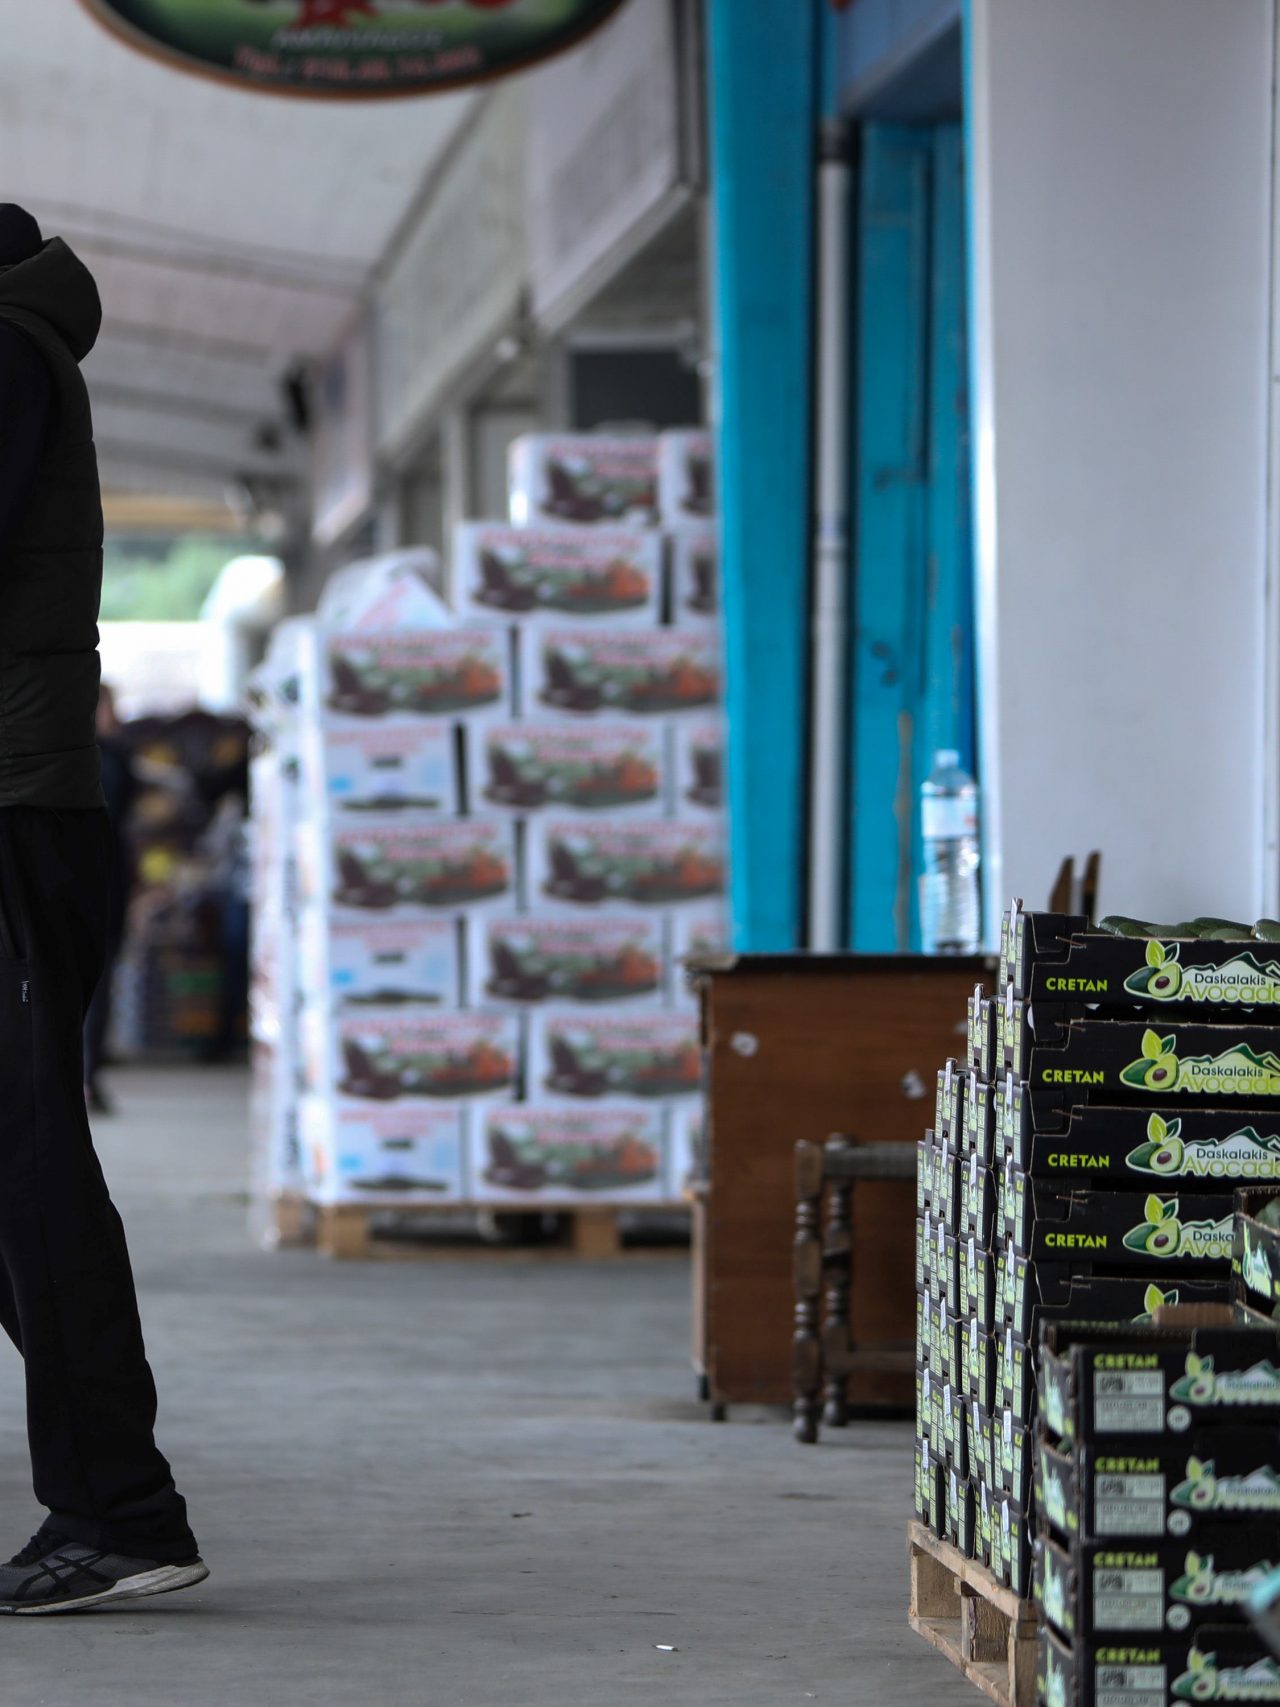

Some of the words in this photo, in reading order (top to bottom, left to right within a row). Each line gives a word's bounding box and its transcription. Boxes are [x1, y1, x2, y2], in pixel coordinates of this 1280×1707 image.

[1046, 977, 1108, 992] CRETAN
[1194, 973, 1266, 986] Daskalakis
[1042, 1069, 1104, 1083] CRETAN
[1191, 1065, 1263, 1077] Daskalakis
[1048, 1153, 1110, 1168] CRETAN
[1196, 1148, 1268, 1160] Daskalakis
[1045, 1233, 1107, 1248] CRETAN
[1193, 1231, 1234, 1242] Daska
